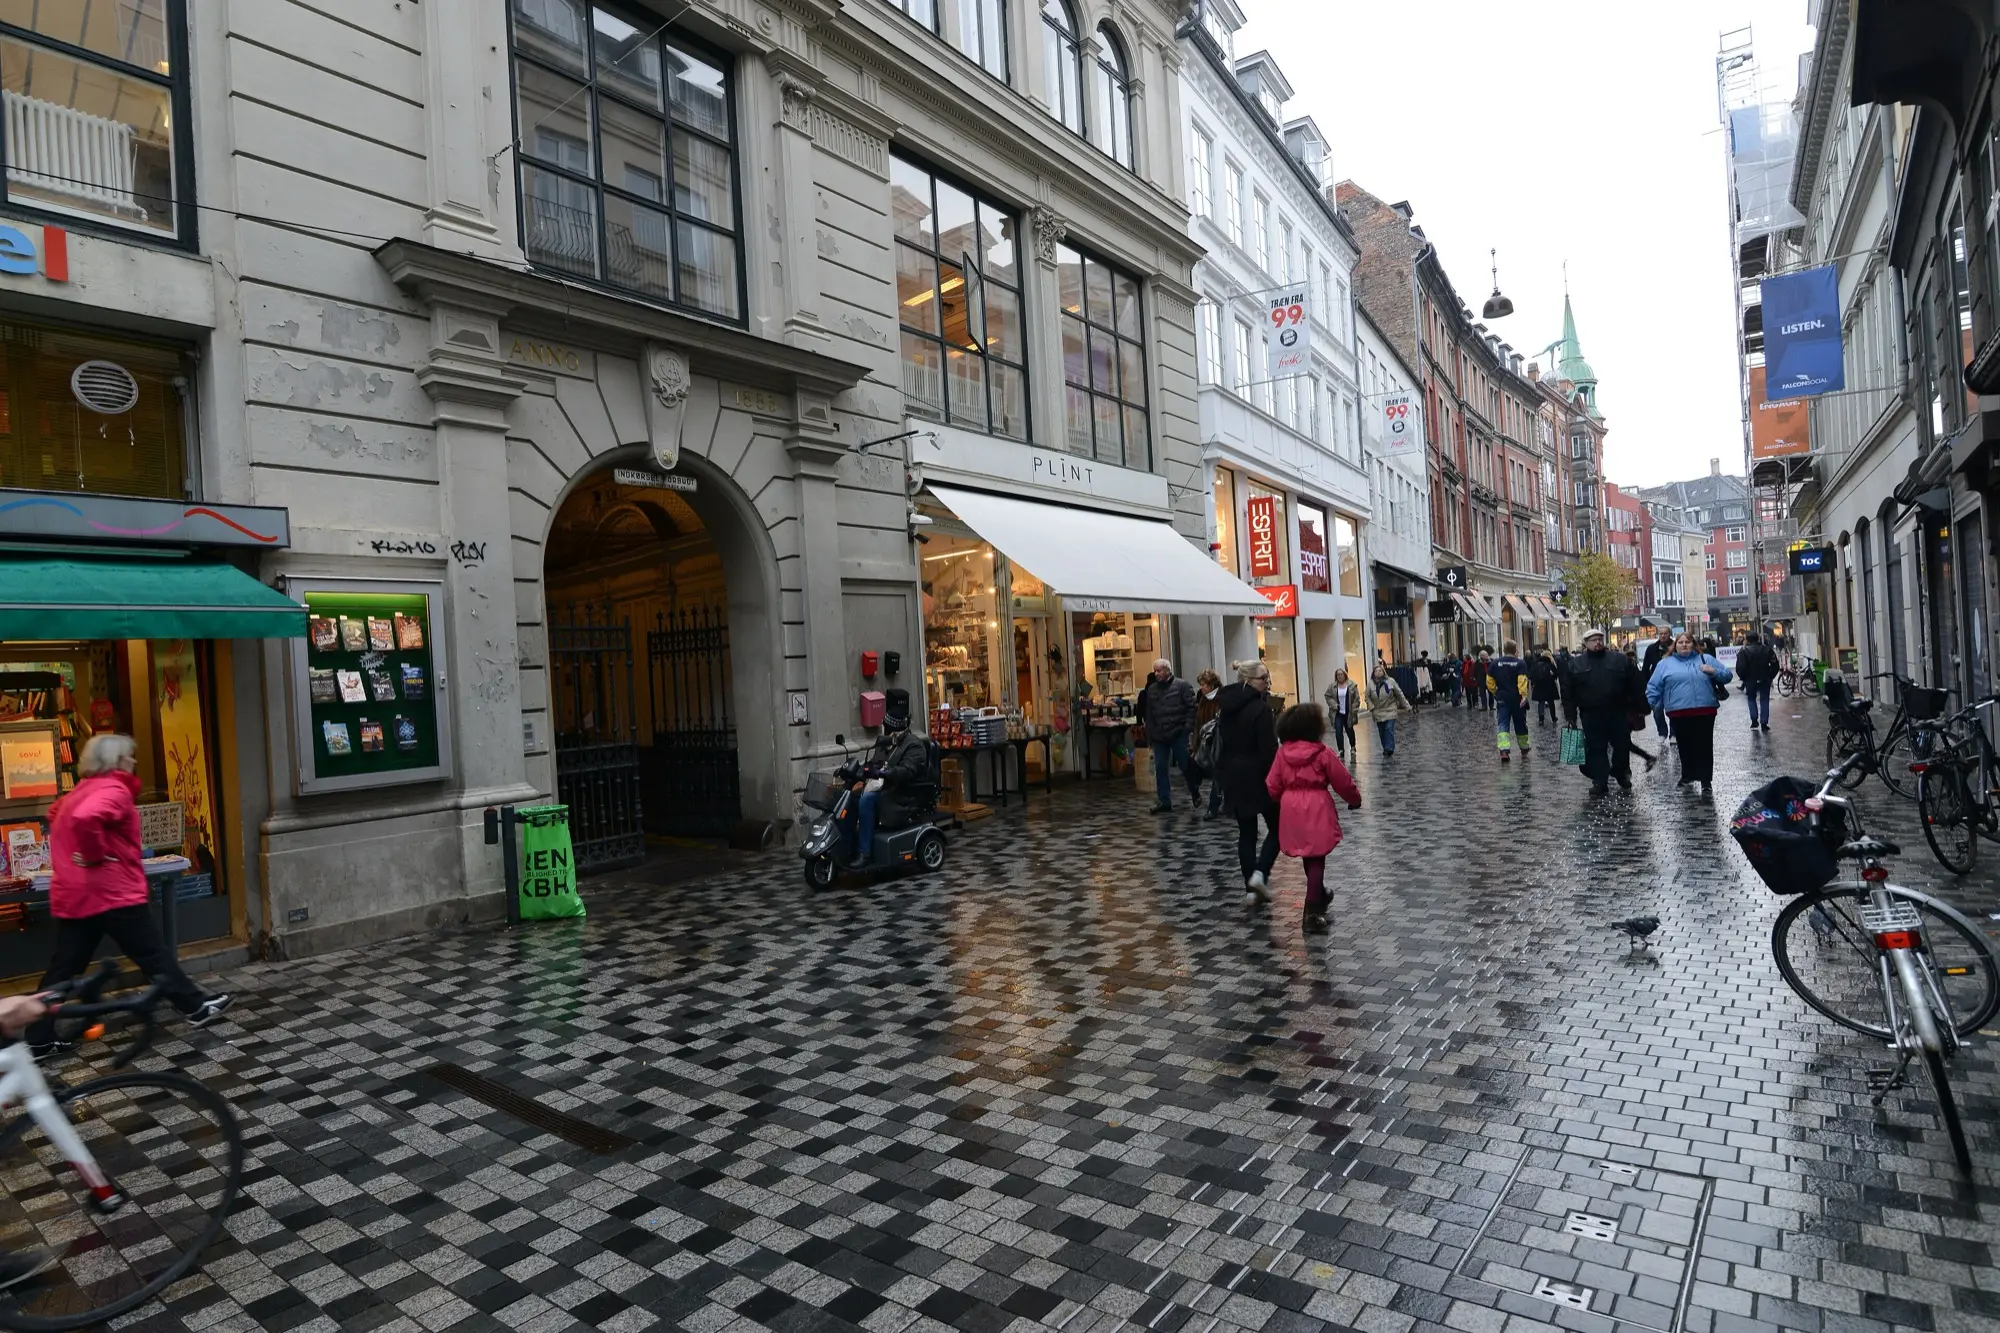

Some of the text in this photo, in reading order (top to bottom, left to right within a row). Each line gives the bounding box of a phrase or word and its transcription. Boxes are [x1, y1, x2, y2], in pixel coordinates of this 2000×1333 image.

[1290, 293, 1304, 305] FRA
[1781, 319, 1825, 335] LISTEN.
[509, 337, 579, 371] ANNO
[1782, 377, 1828, 390] FALCONSOCIAL
[617, 470, 659, 482] INDKØRSEL
[1033, 456, 1093, 483] PLINT
[1252, 502, 1273, 571] ESPRIT
[1300, 551, 1327, 578] ESPRIT
[1801, 557, 1820, 566] TDC
[1082, 598, 1111, 611] PLINT
